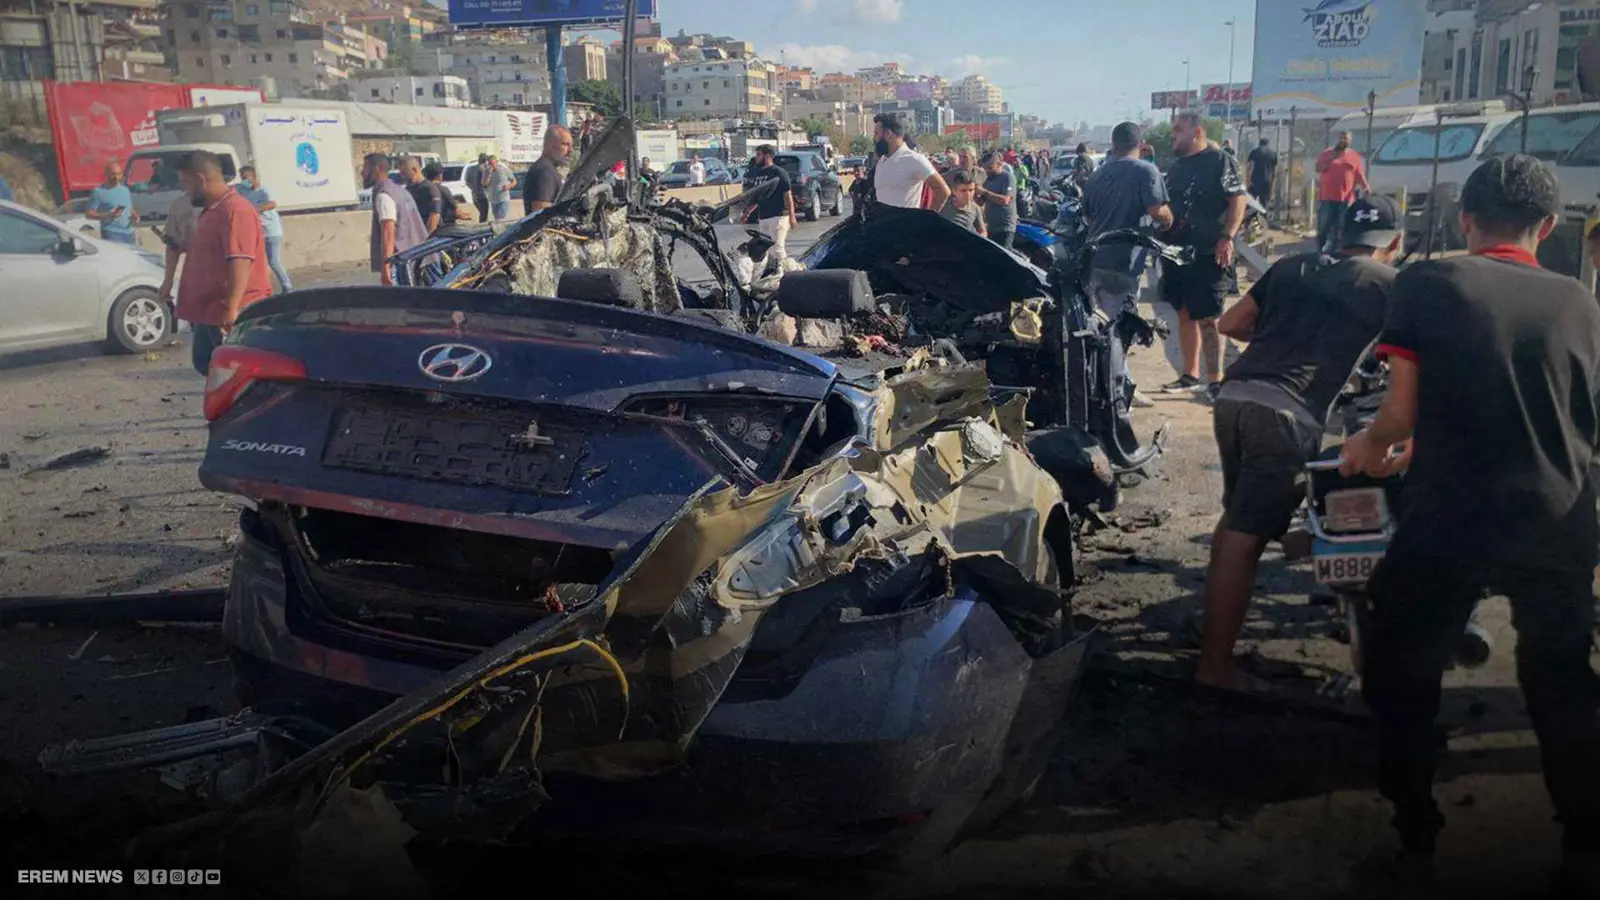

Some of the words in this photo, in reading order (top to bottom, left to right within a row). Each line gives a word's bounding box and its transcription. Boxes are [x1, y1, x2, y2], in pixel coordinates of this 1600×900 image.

[1323, 13, 1361, 25] ABOU
[1314, 23, 1368, 40] ZIAD
[221, 440, 306, 456] SONATA
